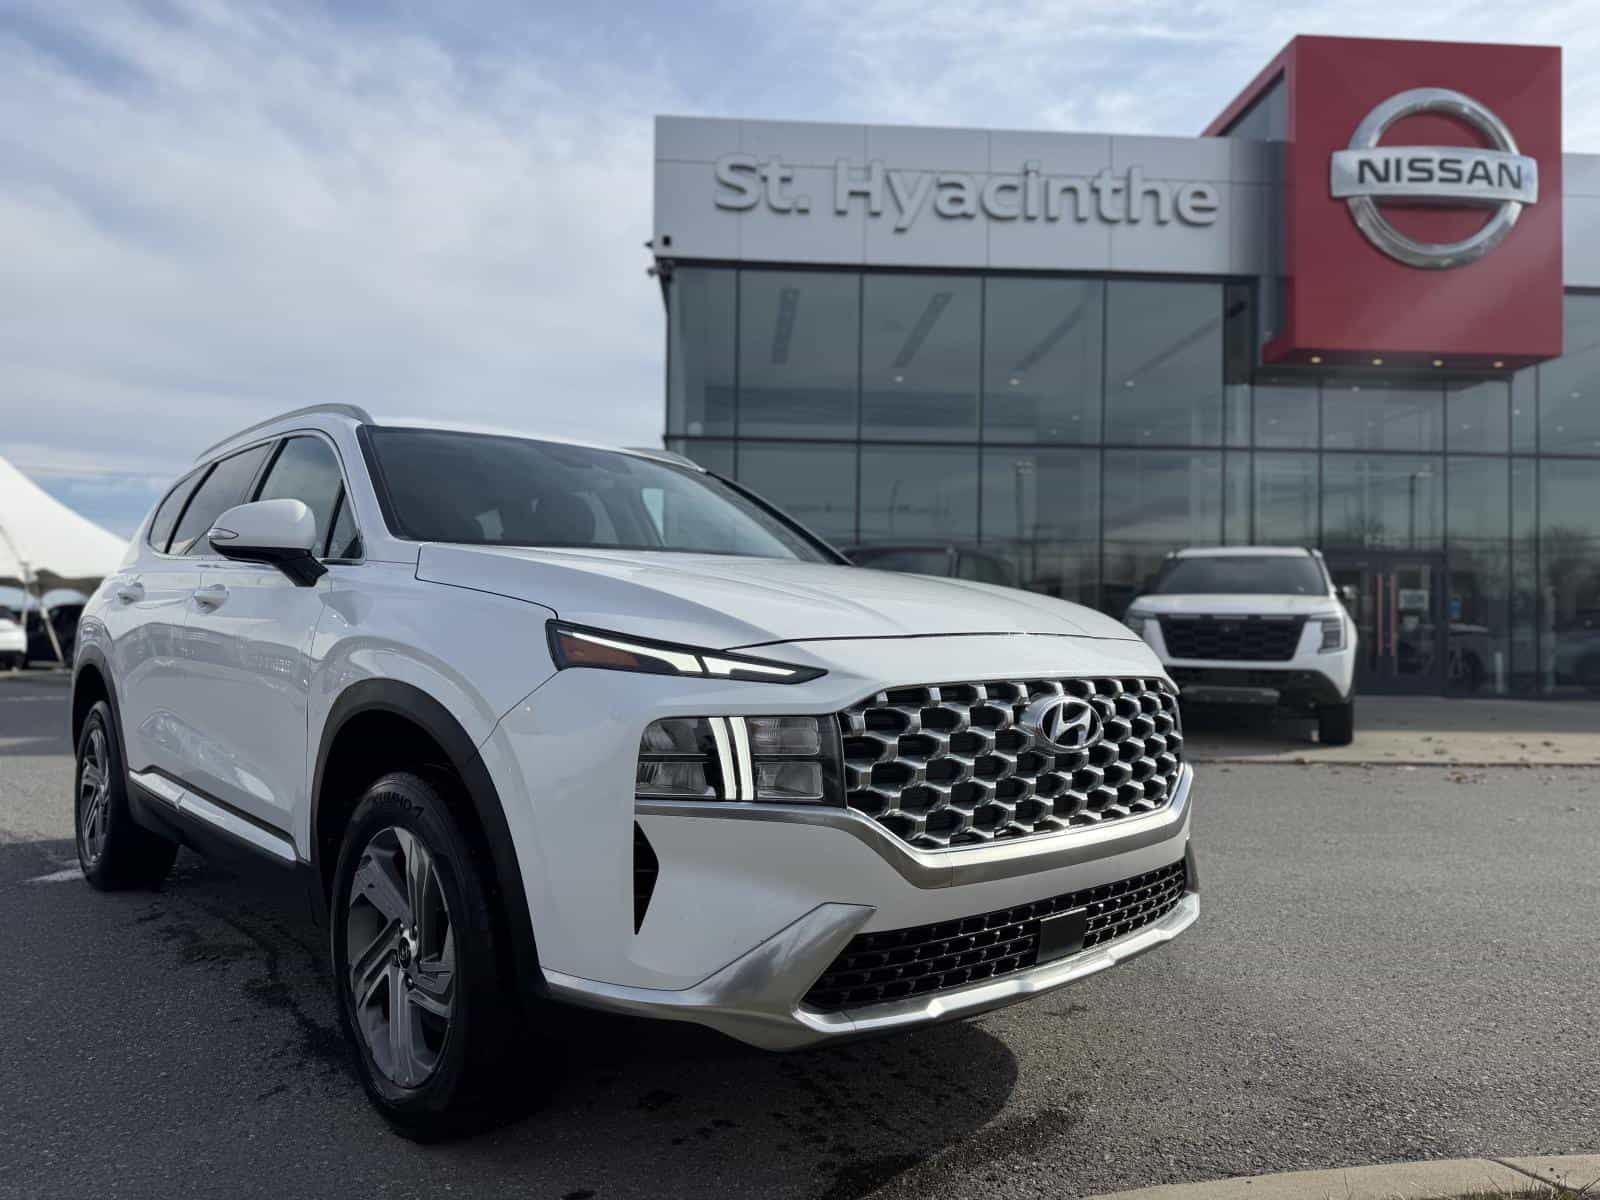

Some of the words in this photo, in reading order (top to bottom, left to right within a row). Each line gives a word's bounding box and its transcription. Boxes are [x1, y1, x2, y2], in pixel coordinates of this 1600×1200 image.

[714, 153, 809, 214] St.
[834, 158, 1220, 232] Hyacinthe
[1358, 157, 1522, 189] NISSAN
